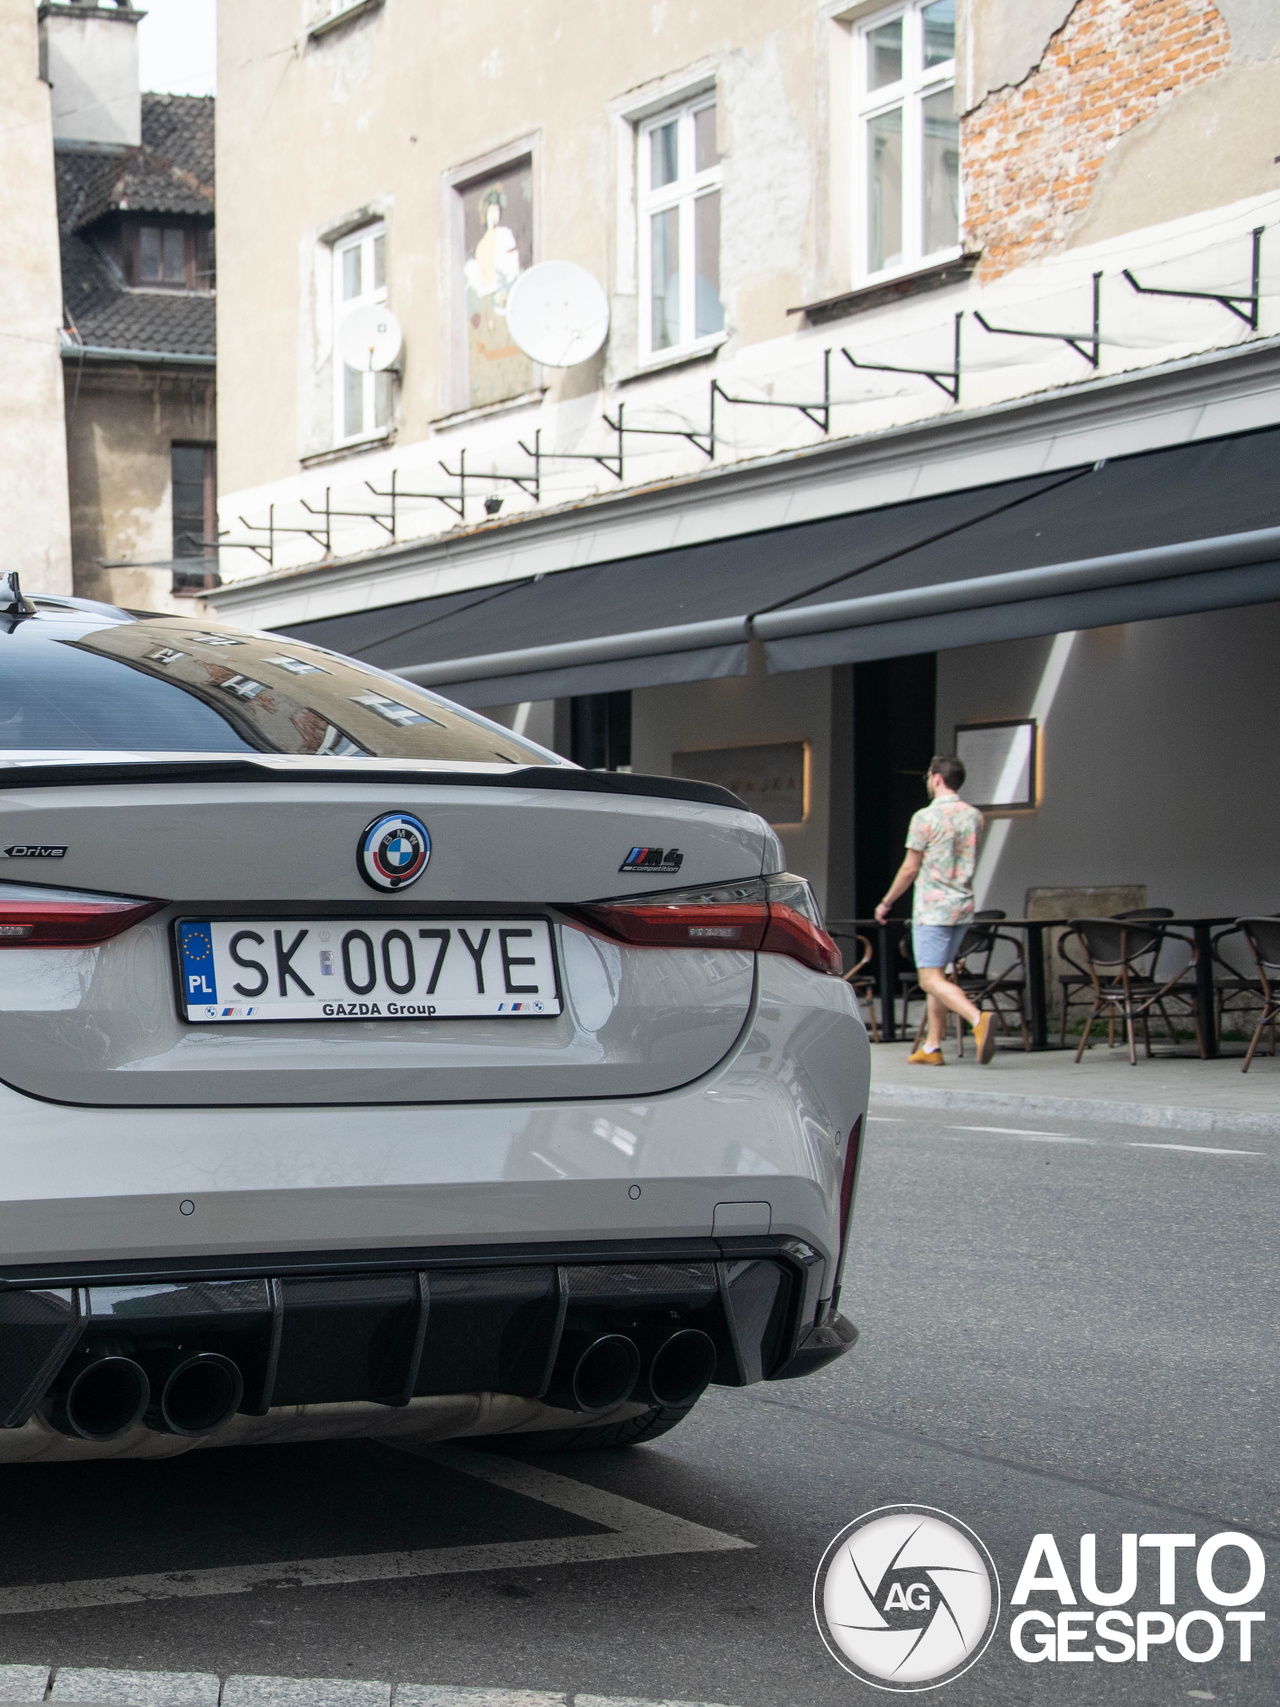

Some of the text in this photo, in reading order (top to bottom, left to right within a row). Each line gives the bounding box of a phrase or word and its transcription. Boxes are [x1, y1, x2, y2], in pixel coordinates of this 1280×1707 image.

[382, 829, 418, 846] BMW
[637, 847, 684, 866] M4
[631, 865, 679, 873] competition
[228, 928, 540, 997] SK 007YE
[188, 975, 213, 993] PL
[322, 1002, 437, 1016] GAZDA Group
